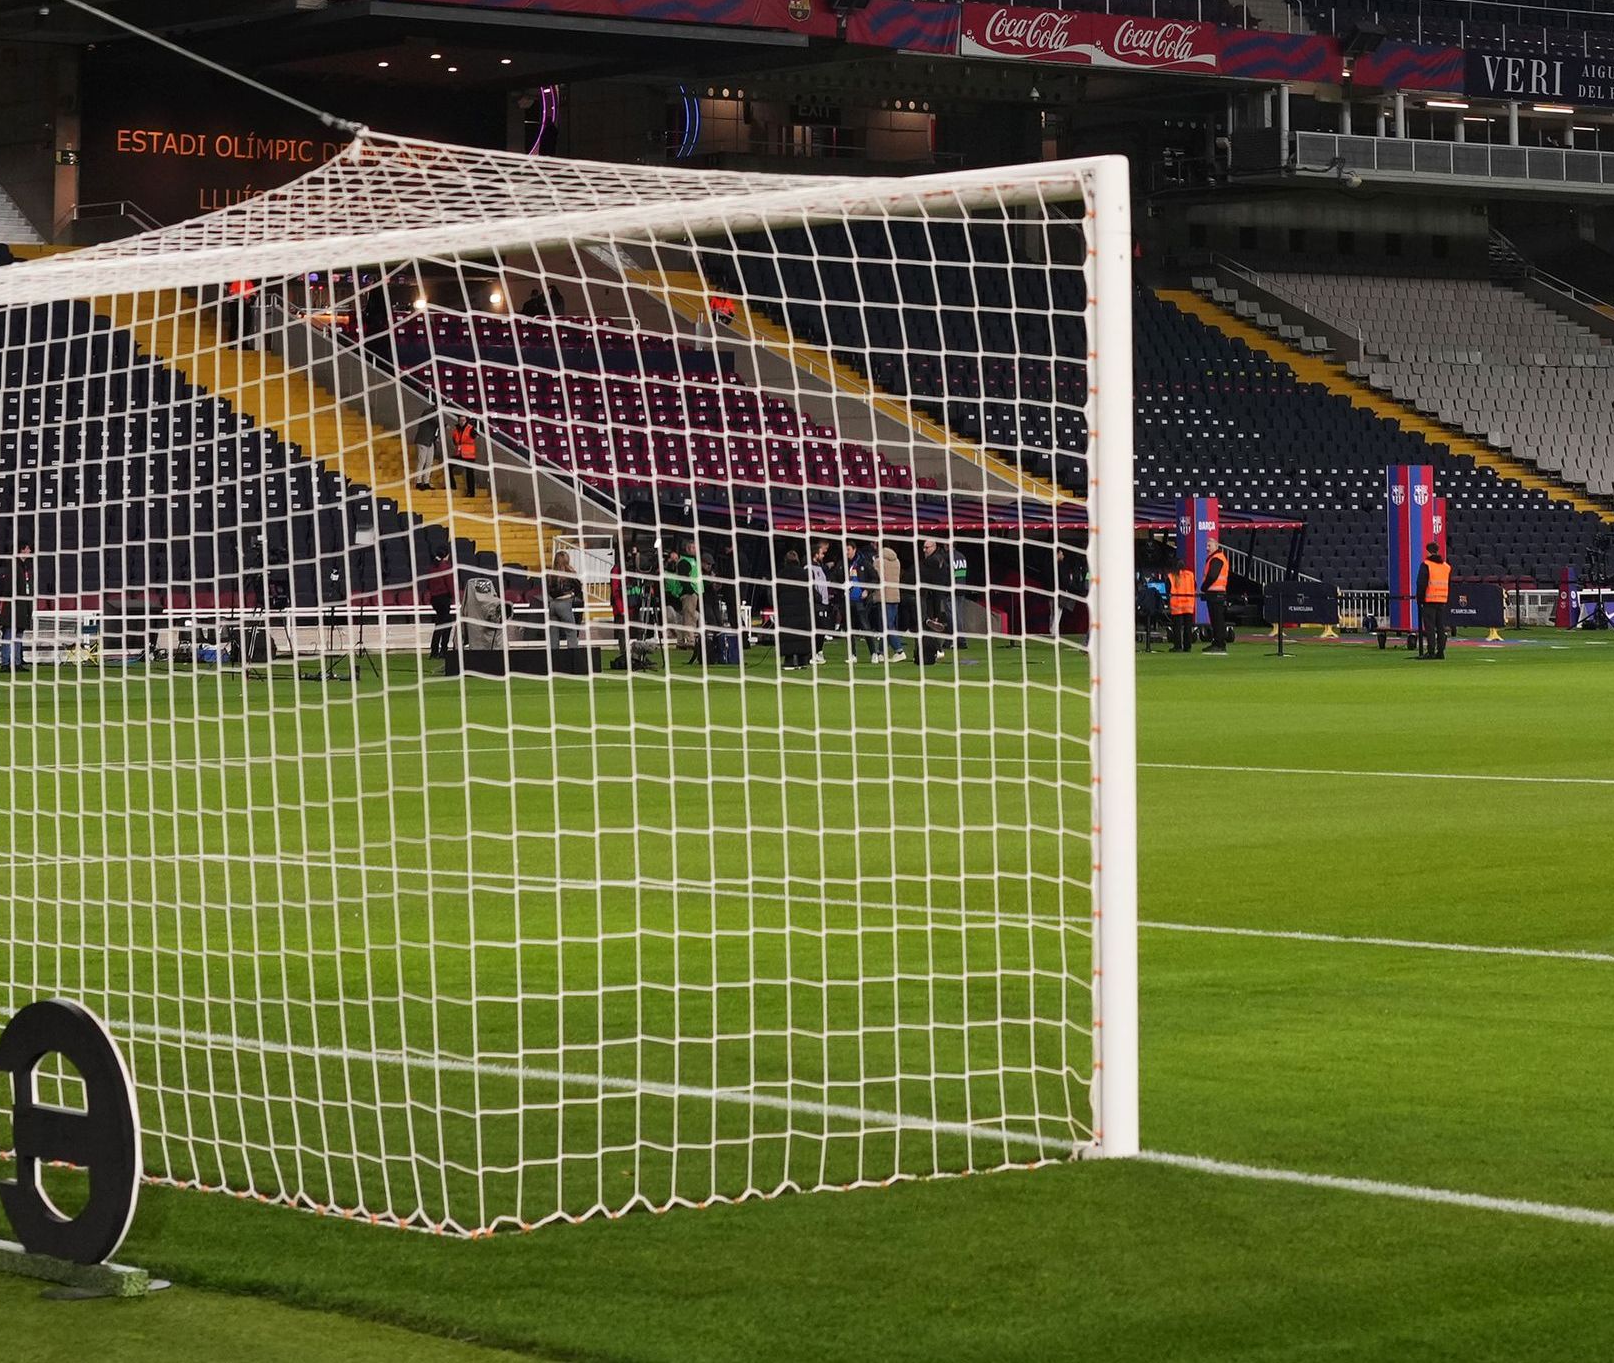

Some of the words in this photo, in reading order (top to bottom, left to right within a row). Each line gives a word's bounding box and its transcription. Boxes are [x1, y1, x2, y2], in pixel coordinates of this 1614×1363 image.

[985, 9, 1073, 50] Coca-Cola
[1113, 19, 1198, 60] Coca-Cola
[1482, 55, 1564, 96] VERI
[1578, 84, 1605, 100] DEL
[116, 129, 206, 157] ESTADI
[215, 131, 314, 163] OLÍMPIC
